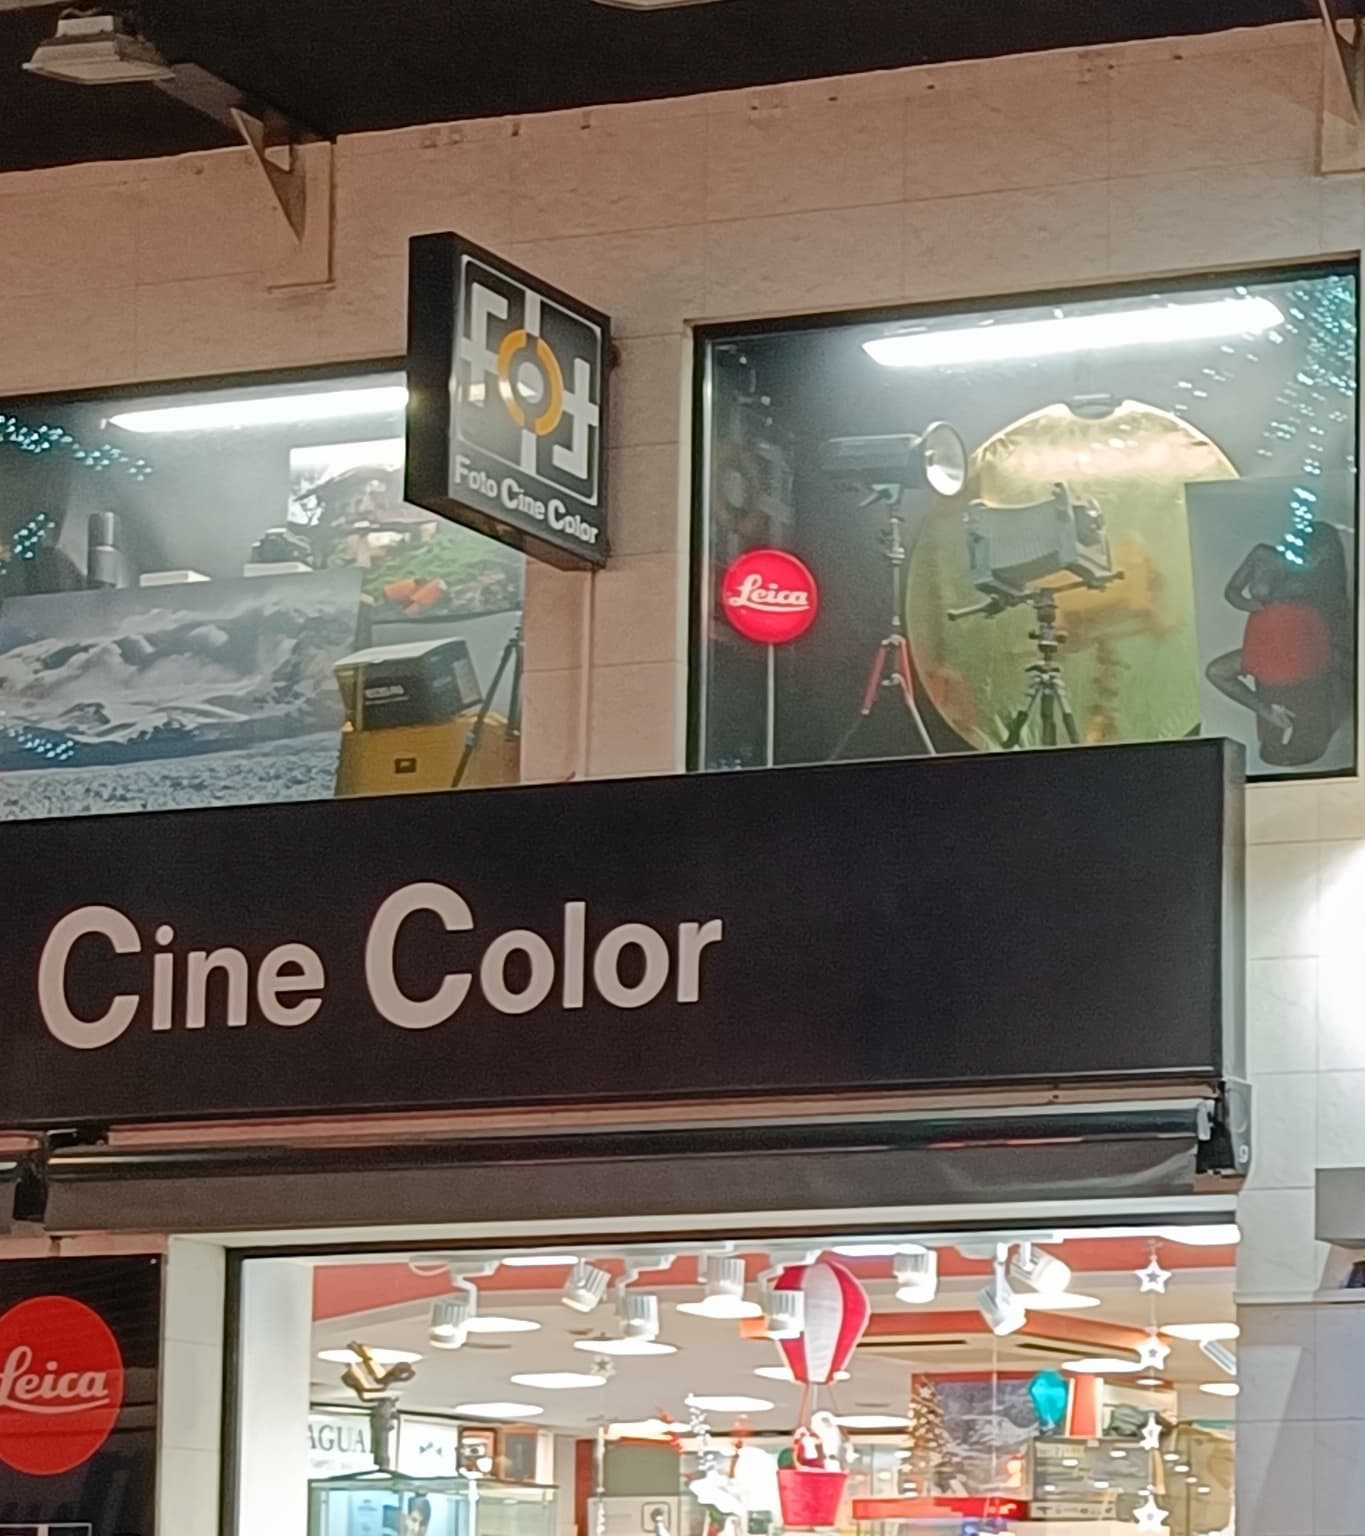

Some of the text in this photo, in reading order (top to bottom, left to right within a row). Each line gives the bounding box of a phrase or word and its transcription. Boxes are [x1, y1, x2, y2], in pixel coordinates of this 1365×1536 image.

[454, 455, 599, 545] Foto Cine Color
[728, 573, 811, 613] Leica
[37, 881, 724, 1050] Cine Color
[0, 1345, 110, 1414] Leica
